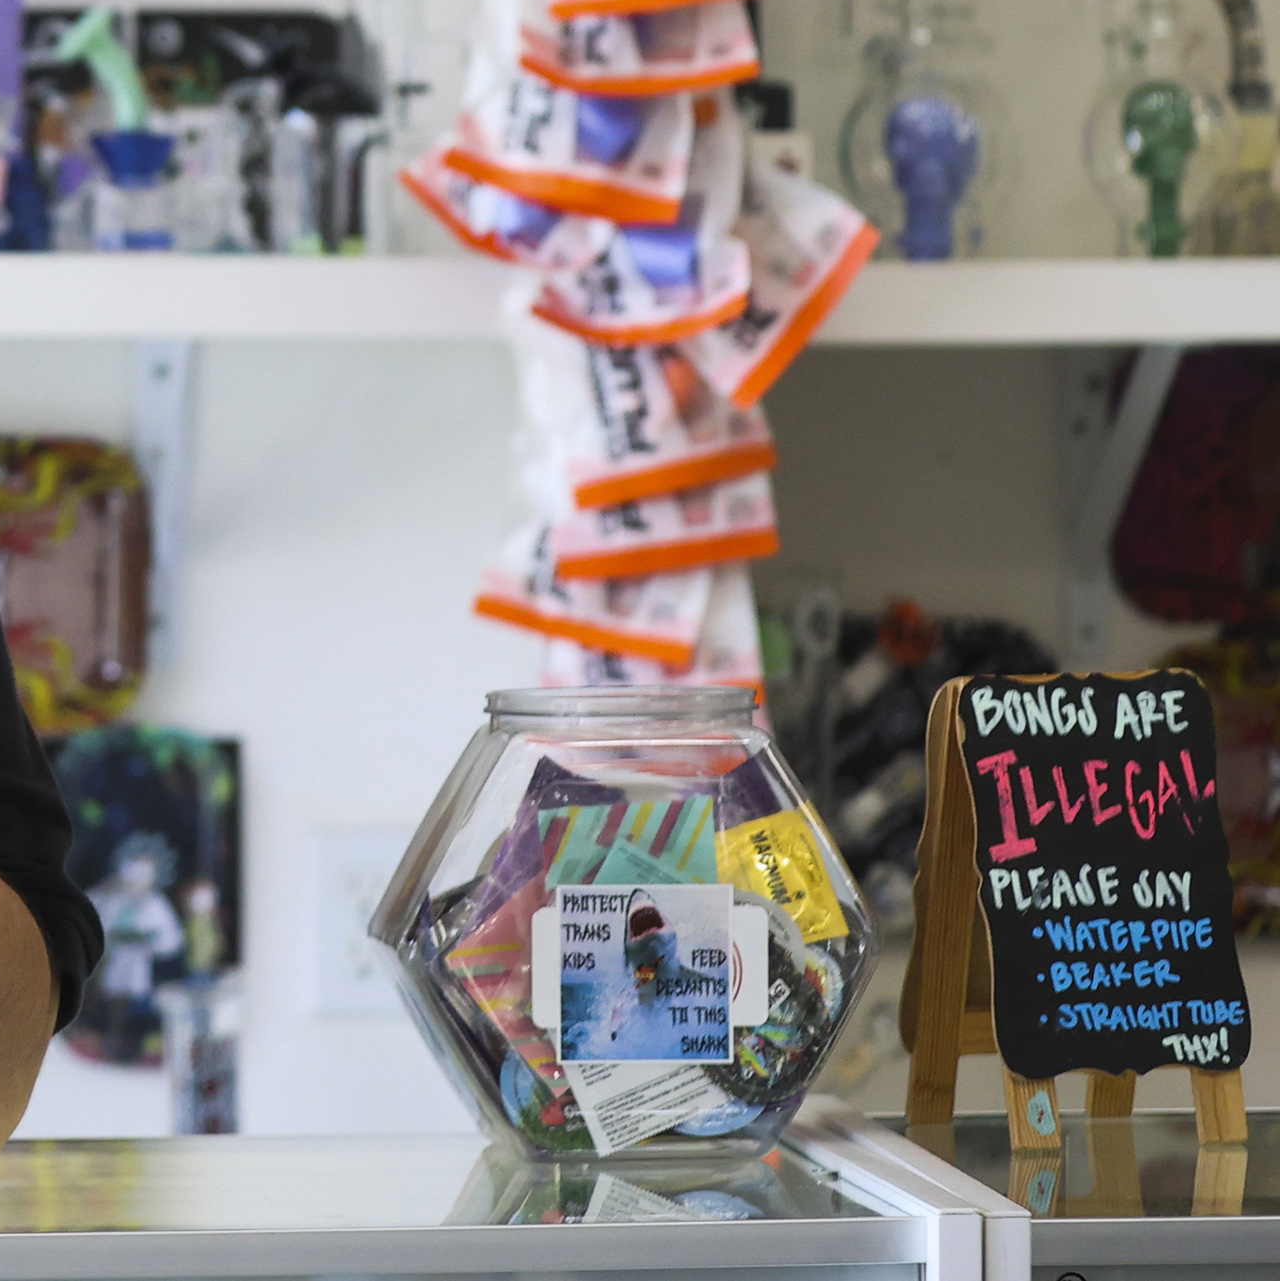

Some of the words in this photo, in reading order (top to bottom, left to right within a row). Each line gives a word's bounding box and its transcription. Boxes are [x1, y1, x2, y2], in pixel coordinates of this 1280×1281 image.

[970, 685, 1098, 738] BONGS
[1114, 689, 1189, 741] ARE
[975, 749, 1216, 864] ILLEGAL
[989, 863, 1120, 913] PLEASE
[1132, 869, 1192, 913] SAY
[562, 893, 629, 915] PROTECT
[562, 922, 611, 942] TRANS
[562, 951, 596, 971] KIDS
[691, 948, 727, 968] FEED
[1050, 959, 1181, 993] BEAKER
[655, 977, 727, 998] DESANTIS
[668, 1006, 689, 1026] TO
[694, 1006, 727, 1026] THIS
[1059, 1001, 1183, 1032] STRAIGHT
[1187, 999, 1245, 1027] TUBE
[680, 1034, 729, 1055] SHARK
